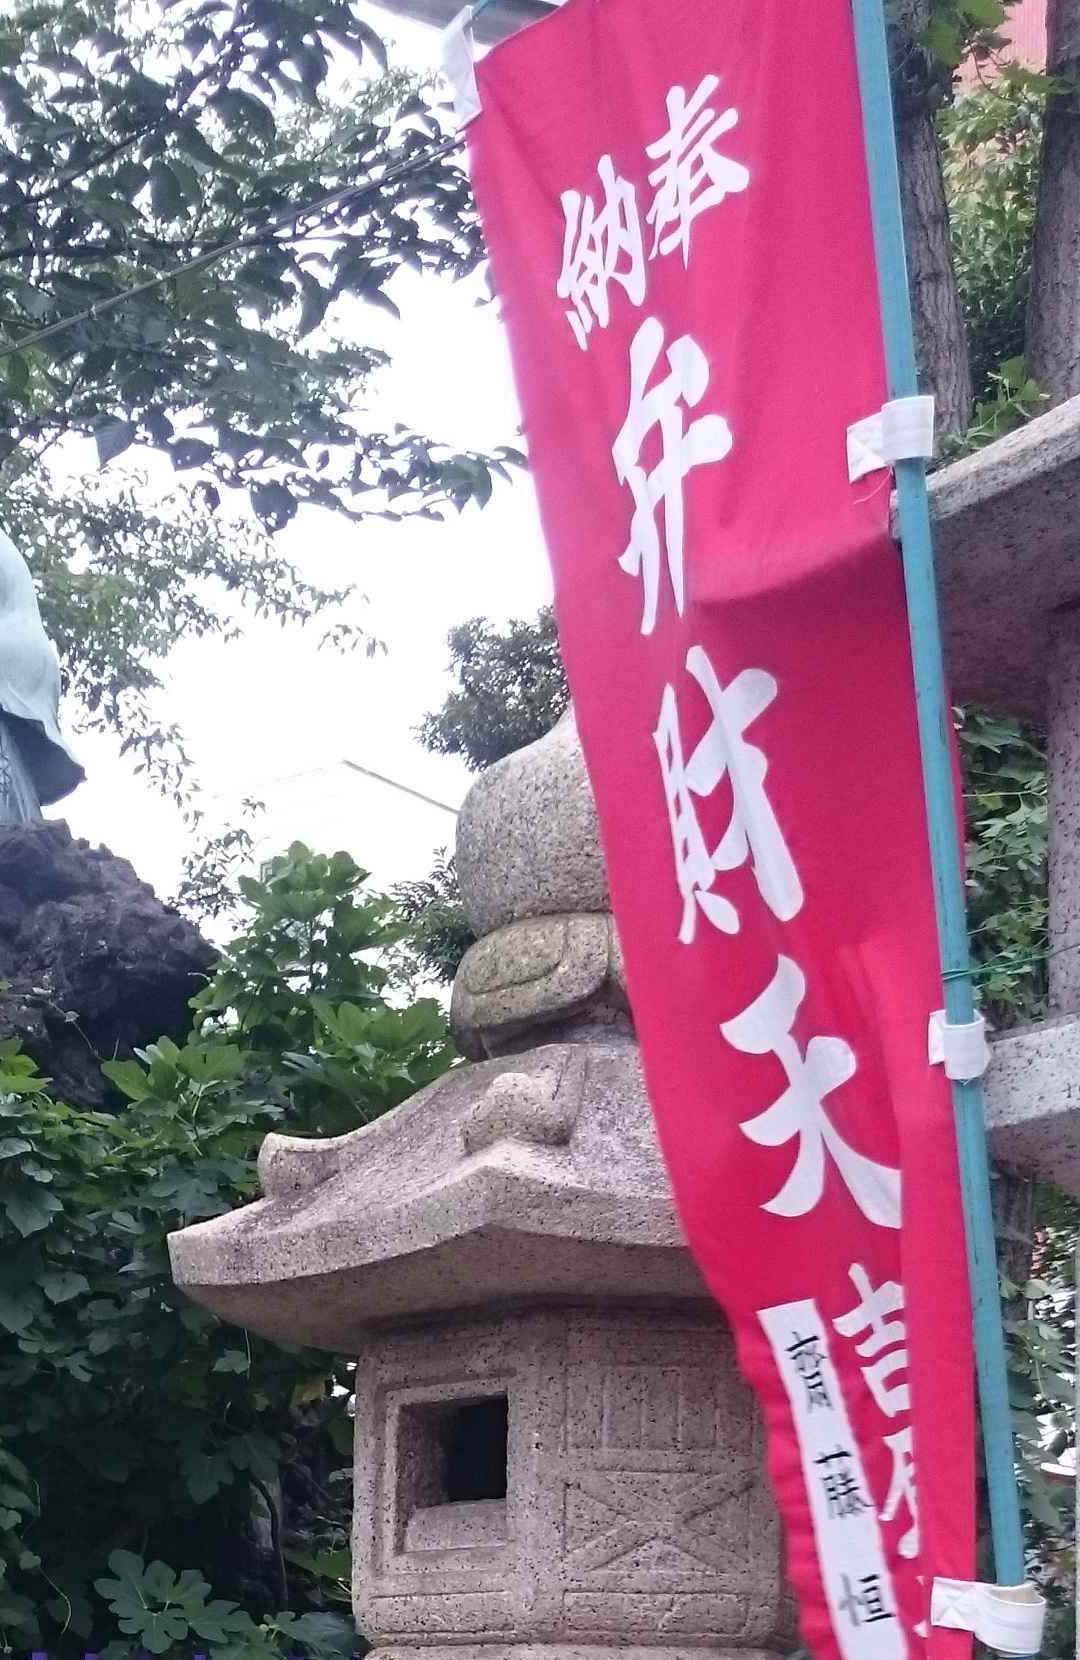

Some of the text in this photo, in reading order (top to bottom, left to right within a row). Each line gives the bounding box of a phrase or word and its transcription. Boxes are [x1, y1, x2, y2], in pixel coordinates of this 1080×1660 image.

[556, 74, 749, 351] 奉納
[612, 316, 902, 1229] 弁財天
